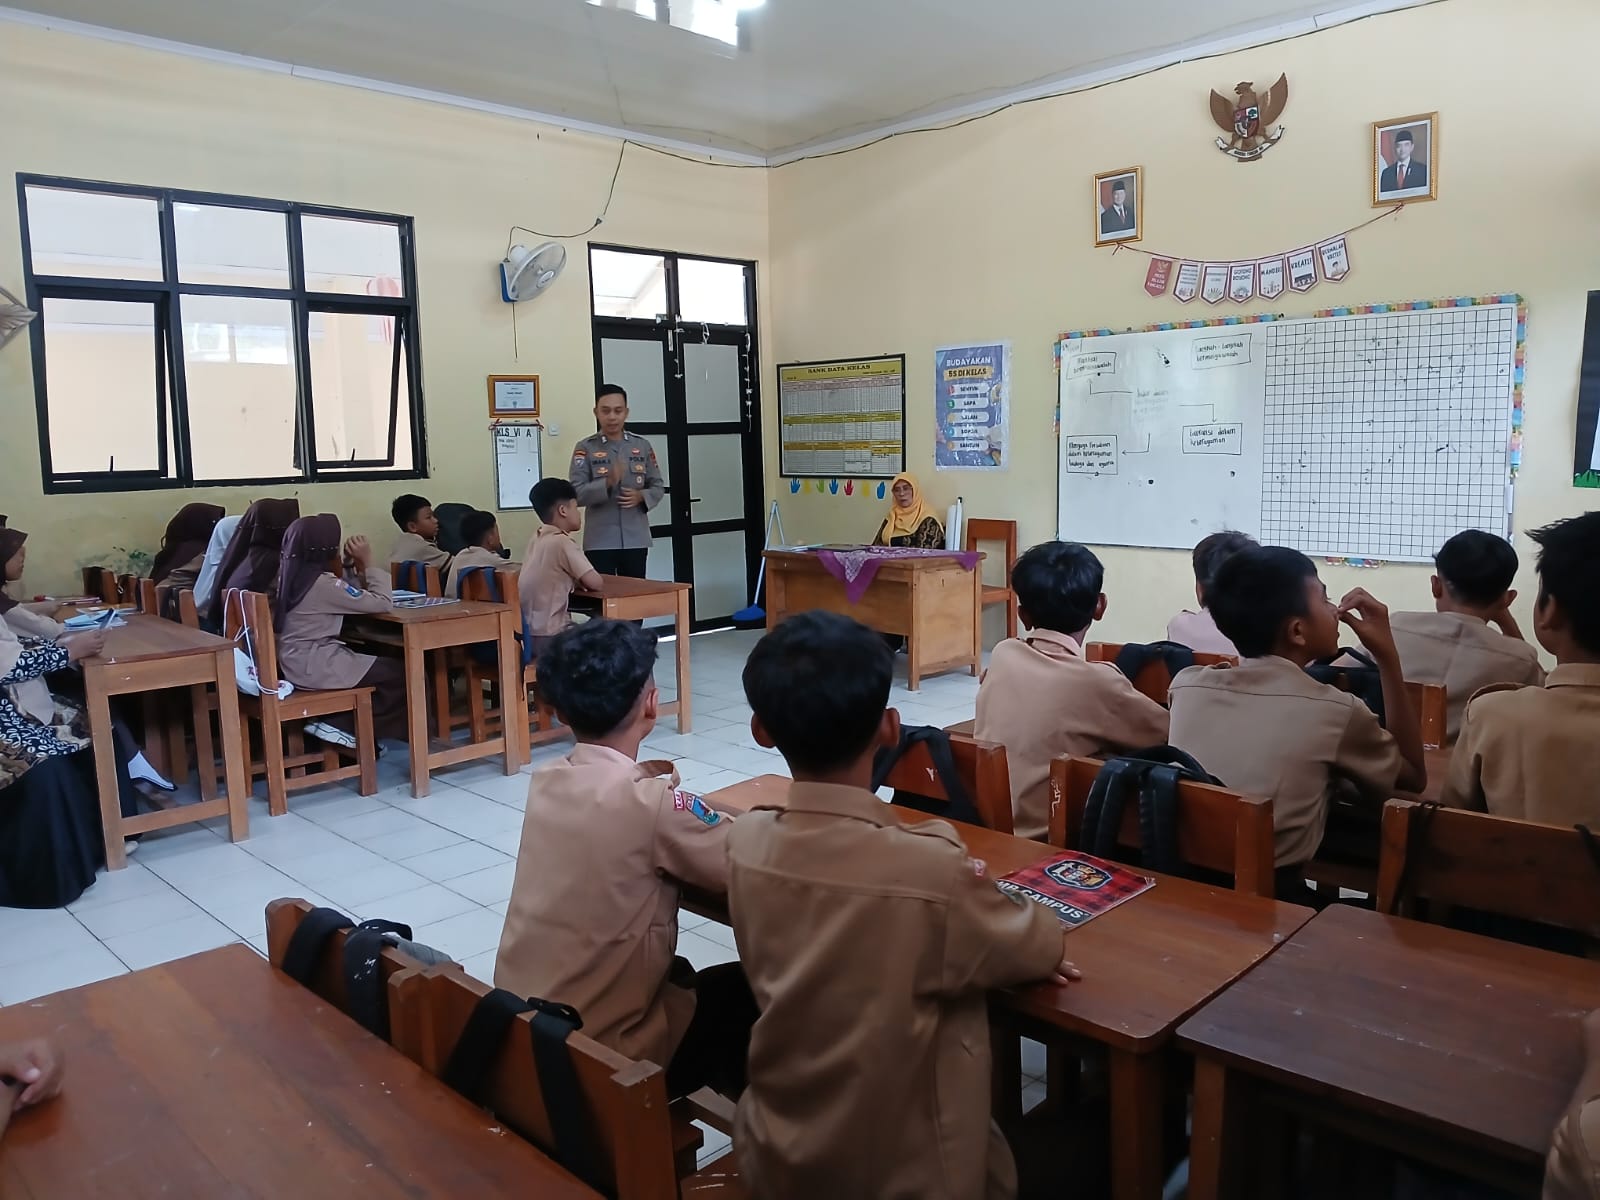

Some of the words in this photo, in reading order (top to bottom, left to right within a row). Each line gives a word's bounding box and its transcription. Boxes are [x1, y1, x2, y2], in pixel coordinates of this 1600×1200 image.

[946, 356, 991, 367] BUDAYAKAN
[966, 367, 987, 376] KELAS
[526, 428, 532, 437] A
